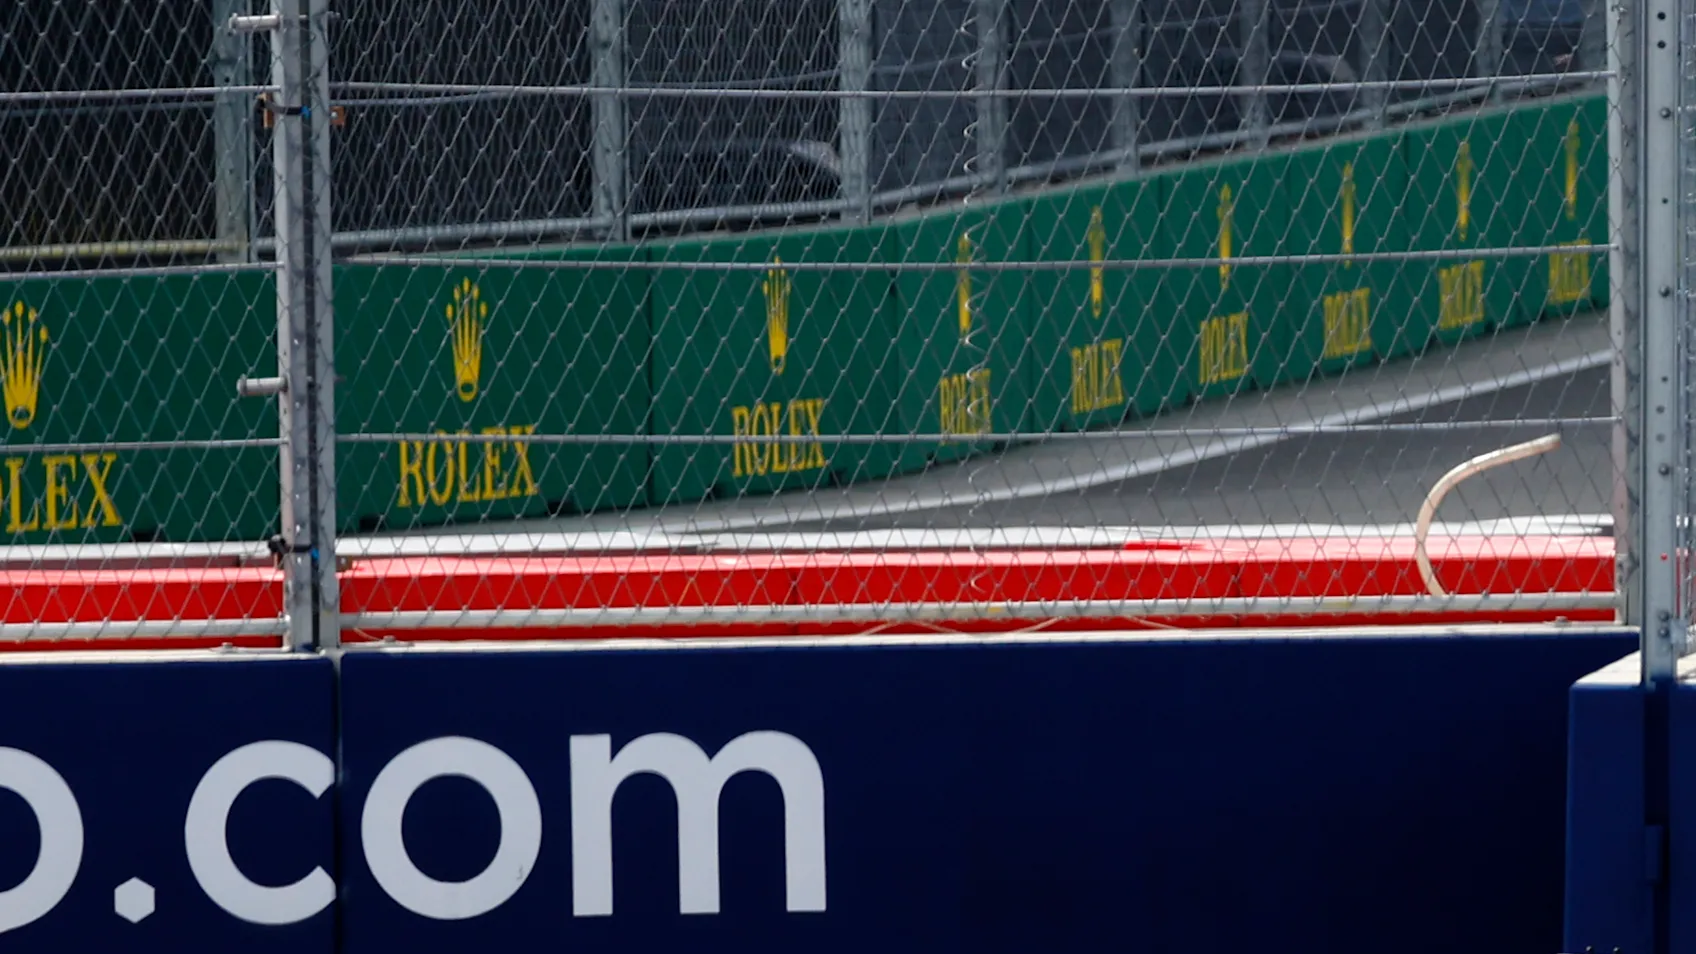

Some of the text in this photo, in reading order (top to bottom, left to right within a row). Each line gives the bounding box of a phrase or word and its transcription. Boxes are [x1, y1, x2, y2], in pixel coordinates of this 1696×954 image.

[397, 424, 538, 508] ROLEX
[731, 398, 828, 477] ROLEX
[0, 453, 122, 534] LEX
